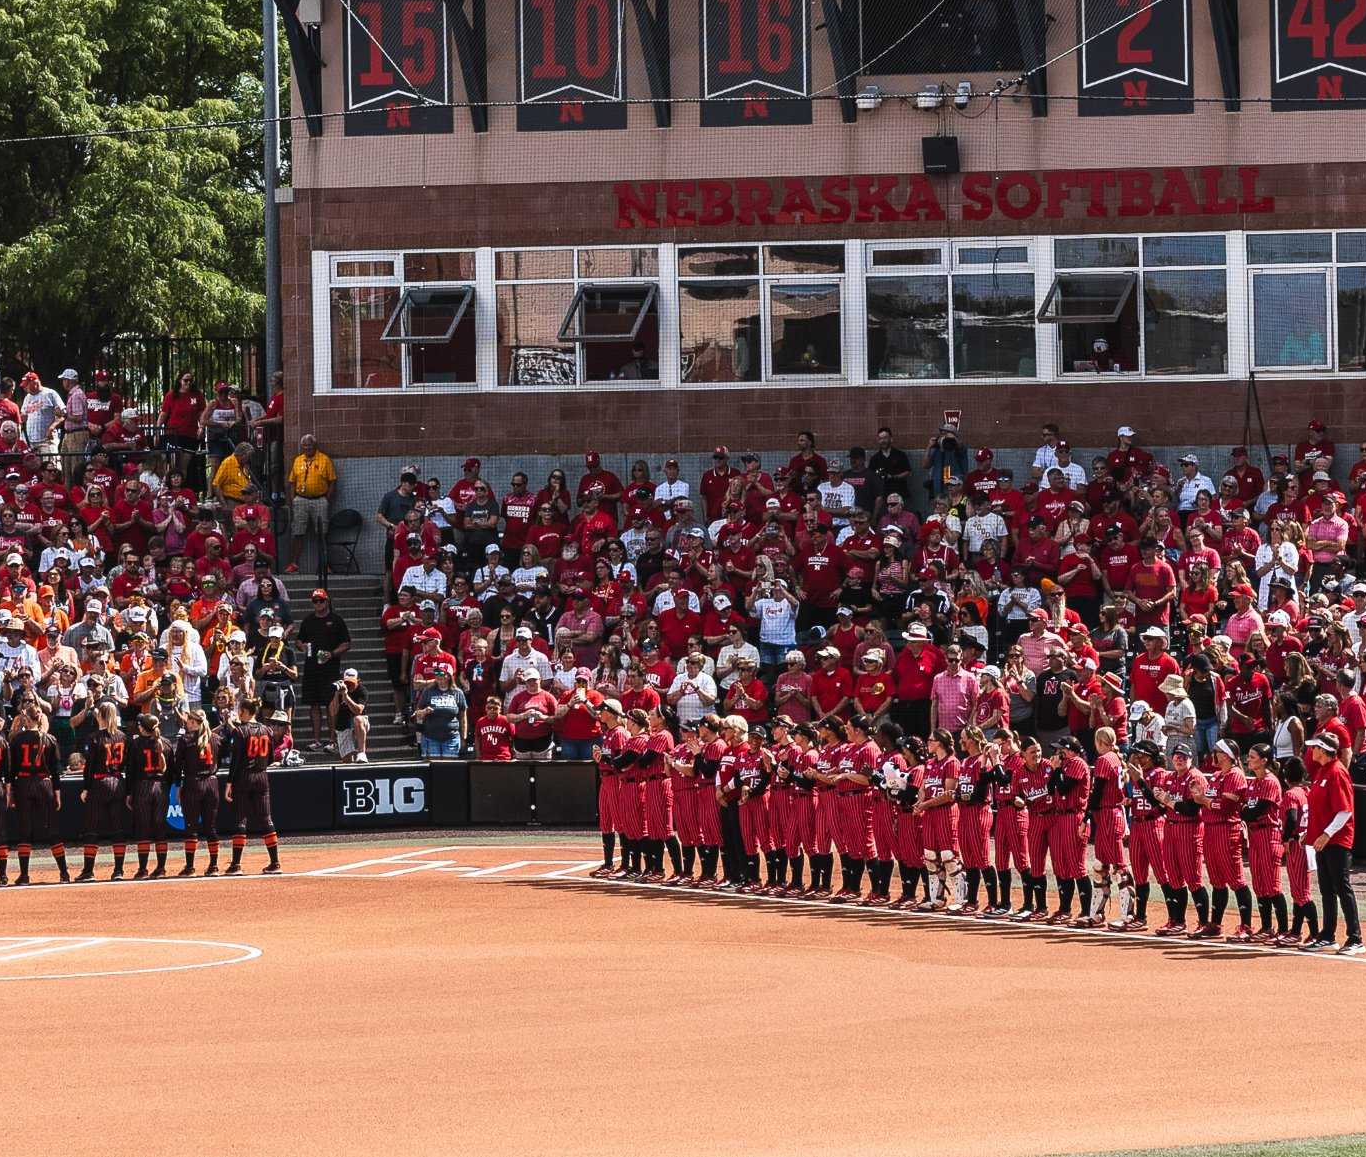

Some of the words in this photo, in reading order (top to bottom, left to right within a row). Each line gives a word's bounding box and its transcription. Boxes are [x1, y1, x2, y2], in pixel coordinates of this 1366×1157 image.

[359, 1, 435, 86] 15
[1124, 81, 1148, 107] N
[1316, 76, 1343, 101] N
[387, 100, 411, 129] N
[560, 96, 584, 122] N
[744, 92, 768, 119] N
[613, 173, 947, 229] NEBRASKA
[960, 167, 1276, 218] SOFTBALL
[1044, 680, 1059, 694] N
[480, 725, 507, 735] NEBRASKA
